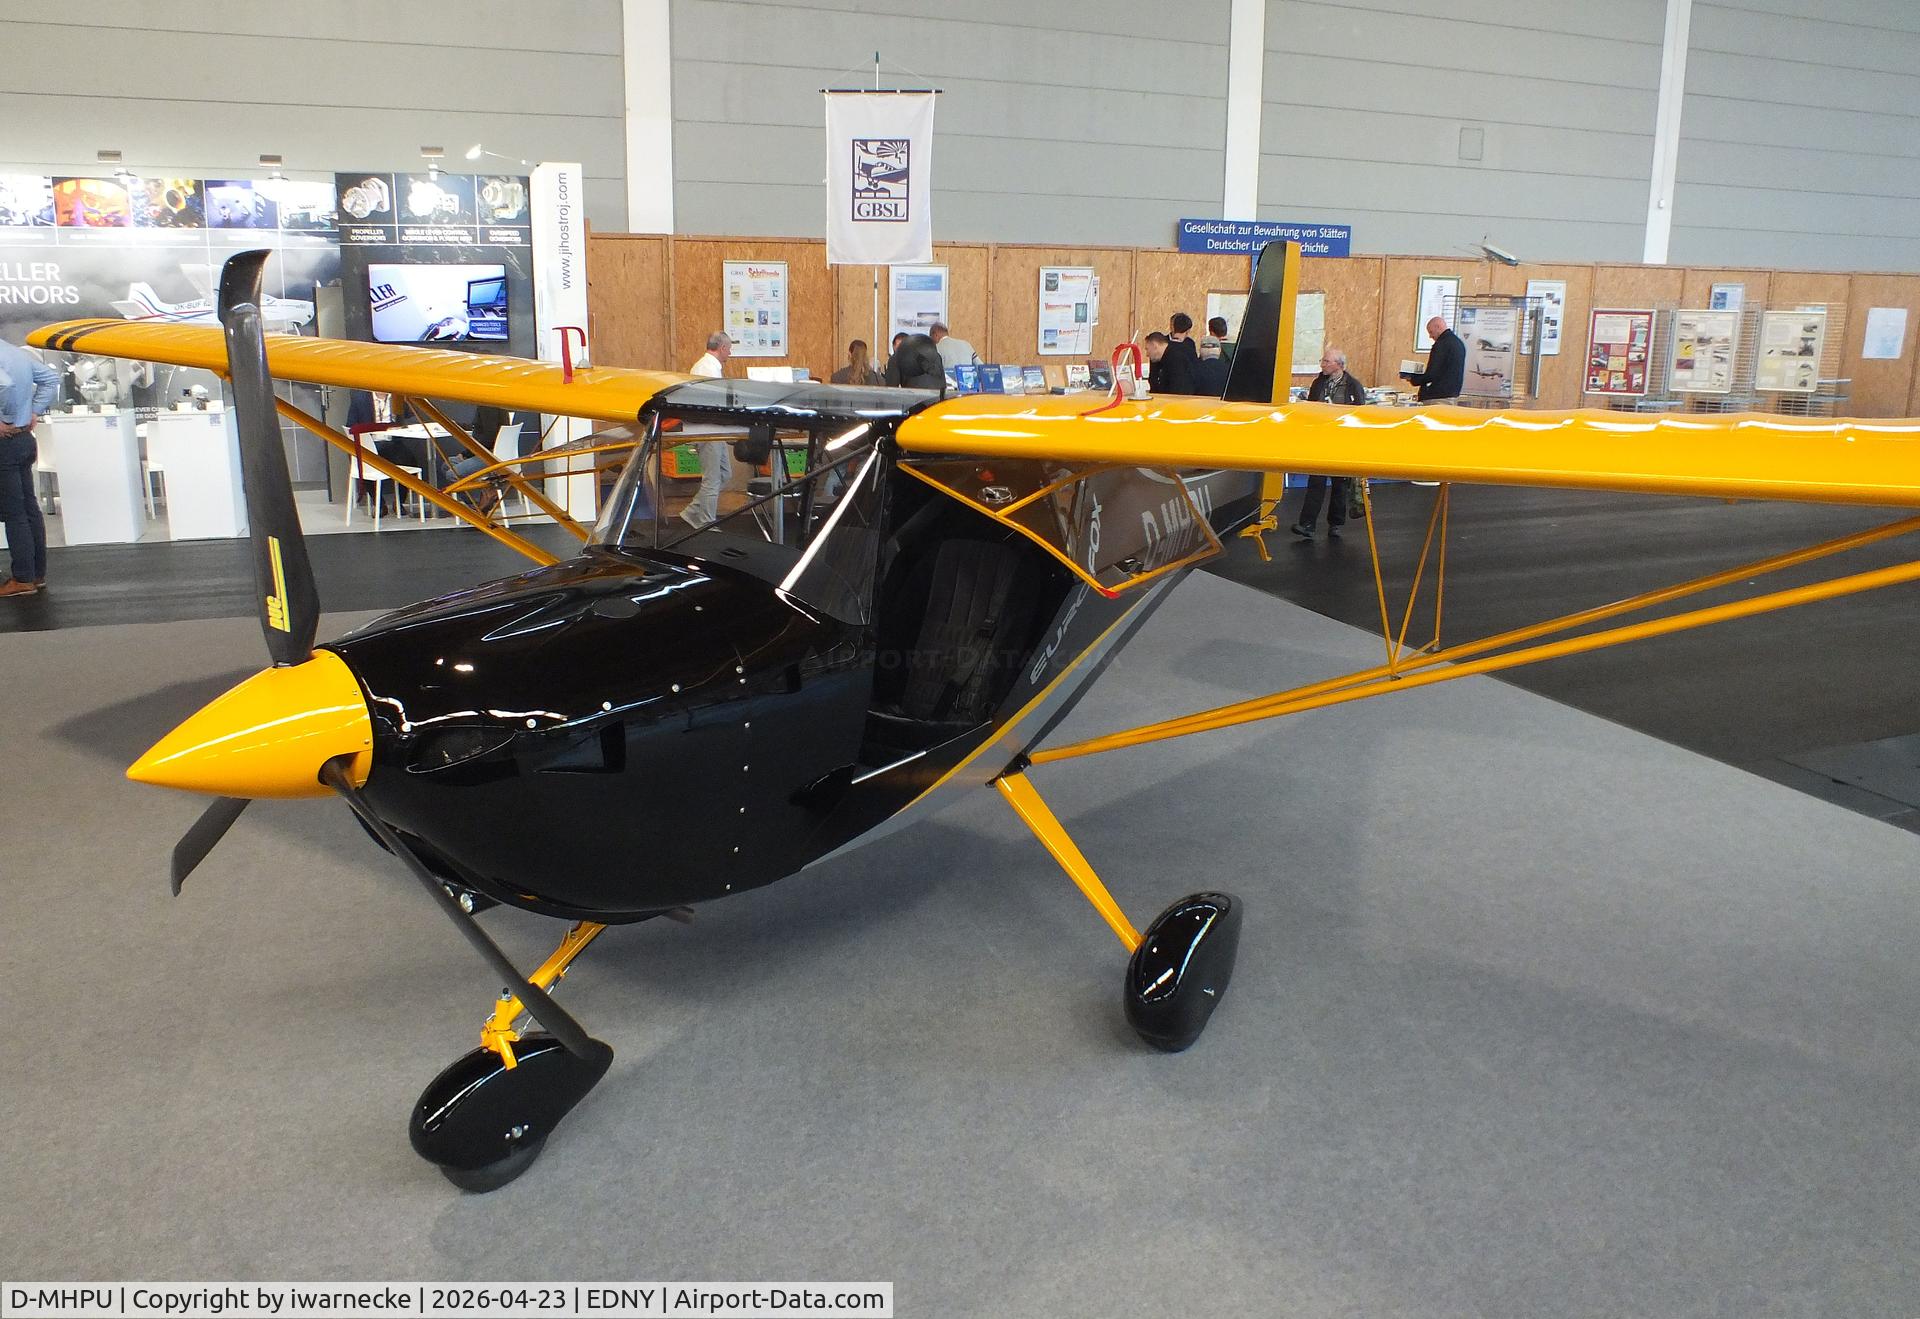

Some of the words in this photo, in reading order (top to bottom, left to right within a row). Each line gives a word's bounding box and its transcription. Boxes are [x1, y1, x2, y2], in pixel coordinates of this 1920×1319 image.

[857, 203, 905, 218] GBSL
[558, 172, 572, 290] www.jihostroj.com
[1184, 222, 1236, 235] Gesellschaft
[1238, 226, 1251, 235] zur
[1254, 226, 1300, 240] Bewahrung
[1302, 229, 1317, 238] von
[1320, 228, 1348, 239] Stätten
[1207, 239, 1249, 251] Deutscher
